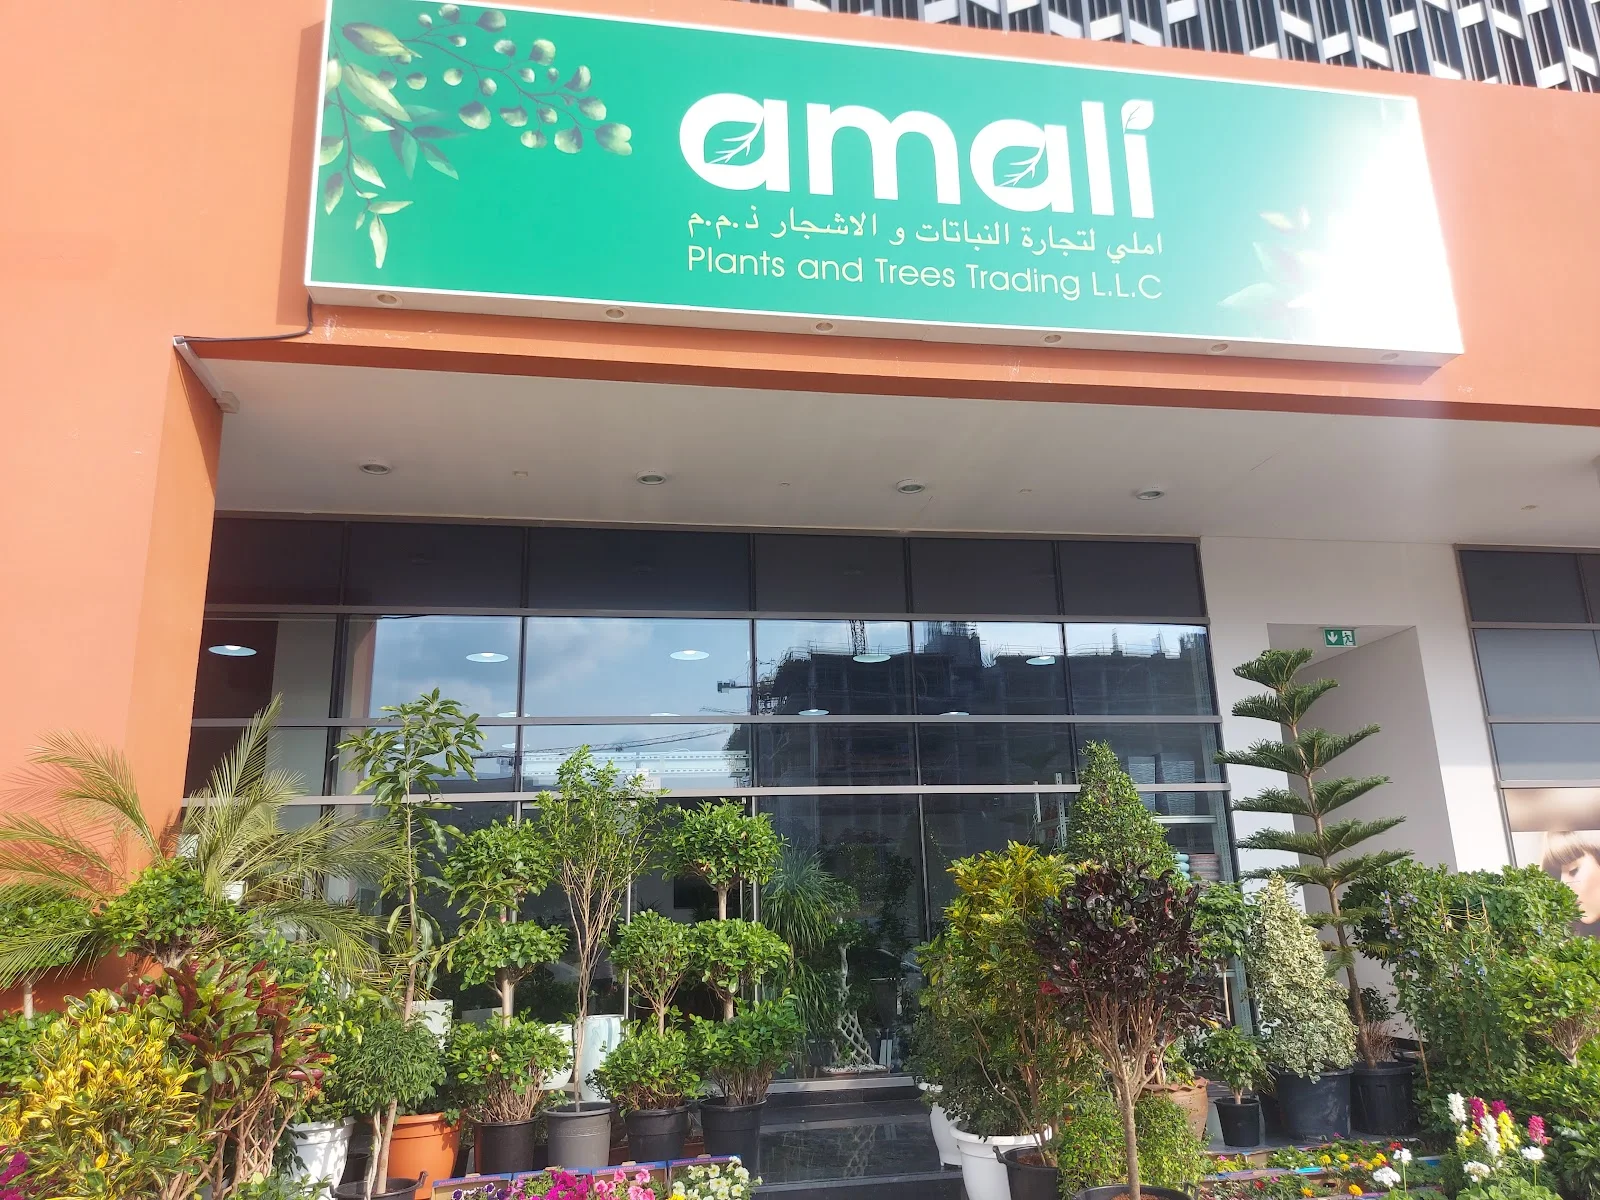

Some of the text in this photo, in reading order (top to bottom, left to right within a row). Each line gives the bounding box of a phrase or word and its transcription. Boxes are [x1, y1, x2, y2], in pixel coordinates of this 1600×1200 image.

[679, 92, 1155, 219] amali
[770, 206, 877, 240] الاشجار
[888, 226, 906, 246] و
[915, 217, 1010, 251] النباتات
[1021, 225, 1096, 257] لتجارة
[1106, 231, 1163, 264] املي
[688, 245, 1162, 301] Plants and Trees Trading L.L.C
